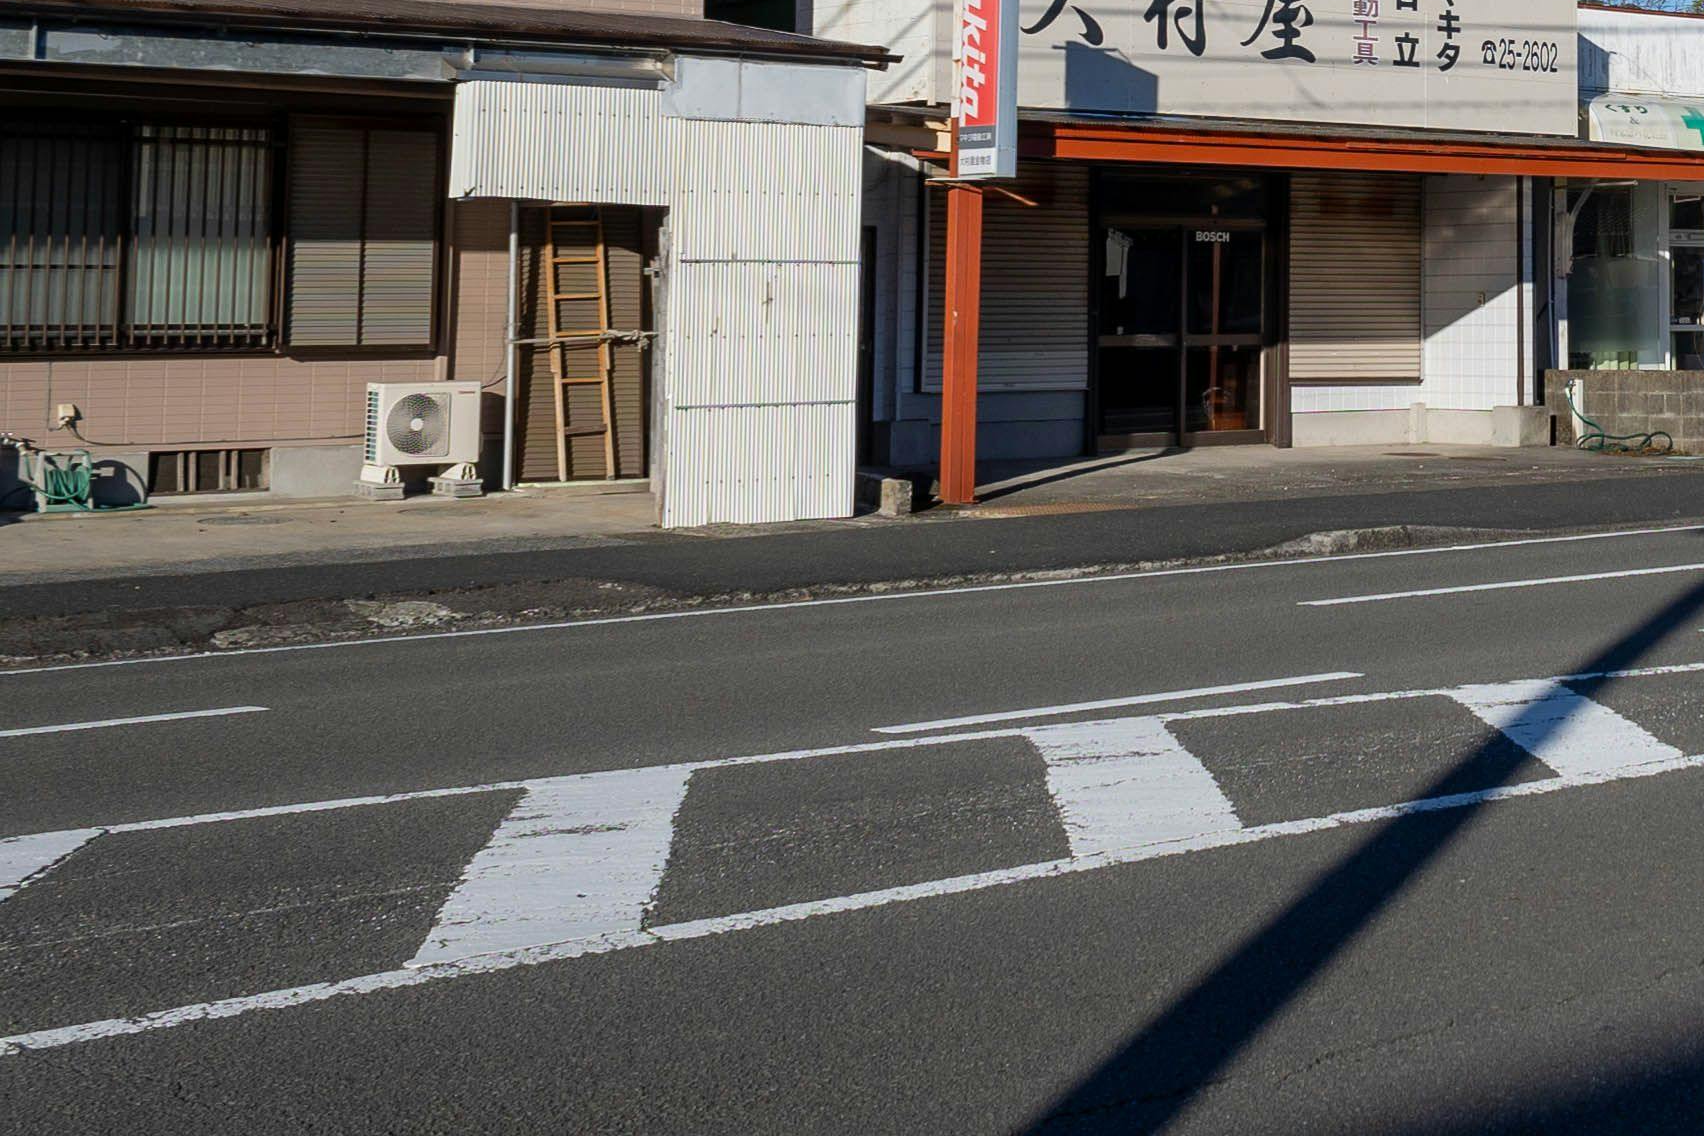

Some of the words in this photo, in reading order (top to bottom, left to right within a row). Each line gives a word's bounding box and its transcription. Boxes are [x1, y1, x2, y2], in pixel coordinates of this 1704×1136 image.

[1498, 38, 1558, 73] 25-2602
[1605, 104, 1648, 114] くすり
[1195, 231, 1230, 243] BOSCH
